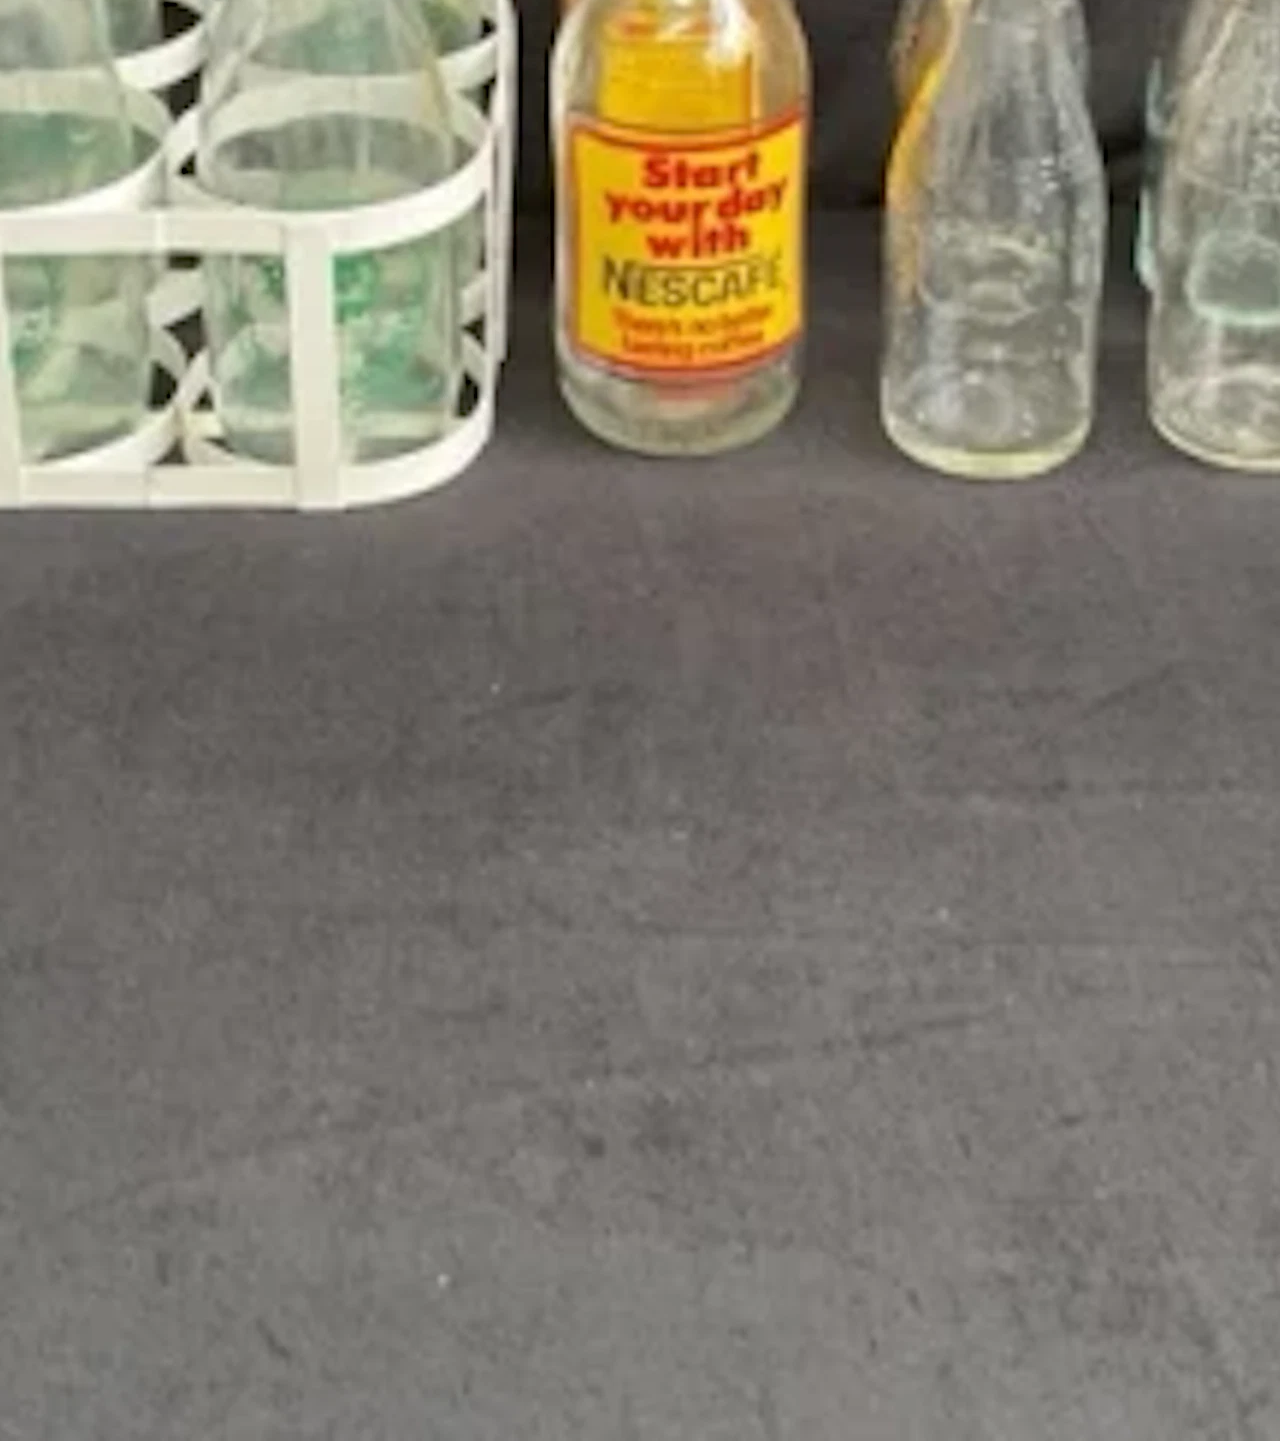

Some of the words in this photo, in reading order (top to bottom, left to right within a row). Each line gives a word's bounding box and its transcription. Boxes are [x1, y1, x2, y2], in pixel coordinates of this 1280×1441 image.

[643, 153, 760, 189] Start
[605, 191, 709, 224] your
[718, 178, 788, 219] day
[646, 226, 752, 259] with
